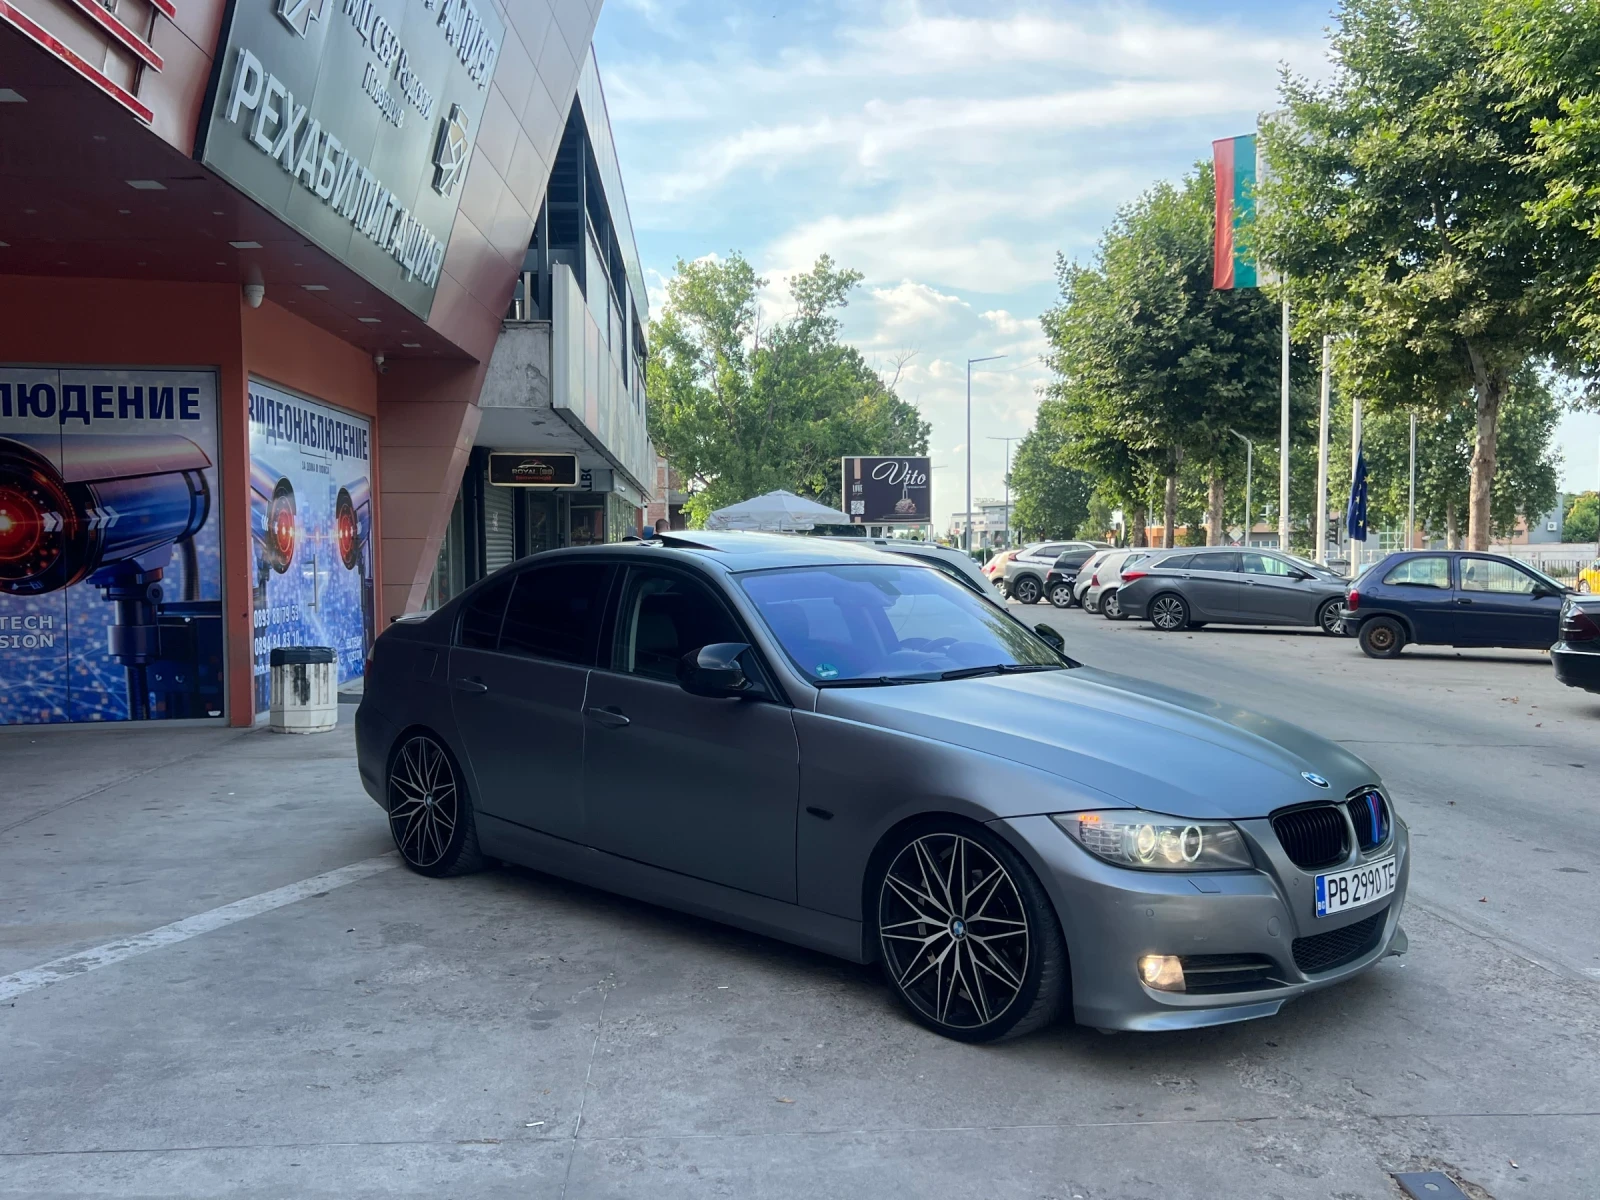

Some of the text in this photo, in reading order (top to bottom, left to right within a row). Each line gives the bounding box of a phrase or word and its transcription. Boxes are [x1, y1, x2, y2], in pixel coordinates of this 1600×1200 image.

[371, 15, 401, 69] СБР
[225, 47, 445, 289] РЕХАБИЛИТАЦИЯ
[871, 461, 926, 486] Vito
[0, 615, 53, 630] TECH
[0, 634, 54, 648] SION
[1328, 861, 1395, 909] PB 2990 TE
